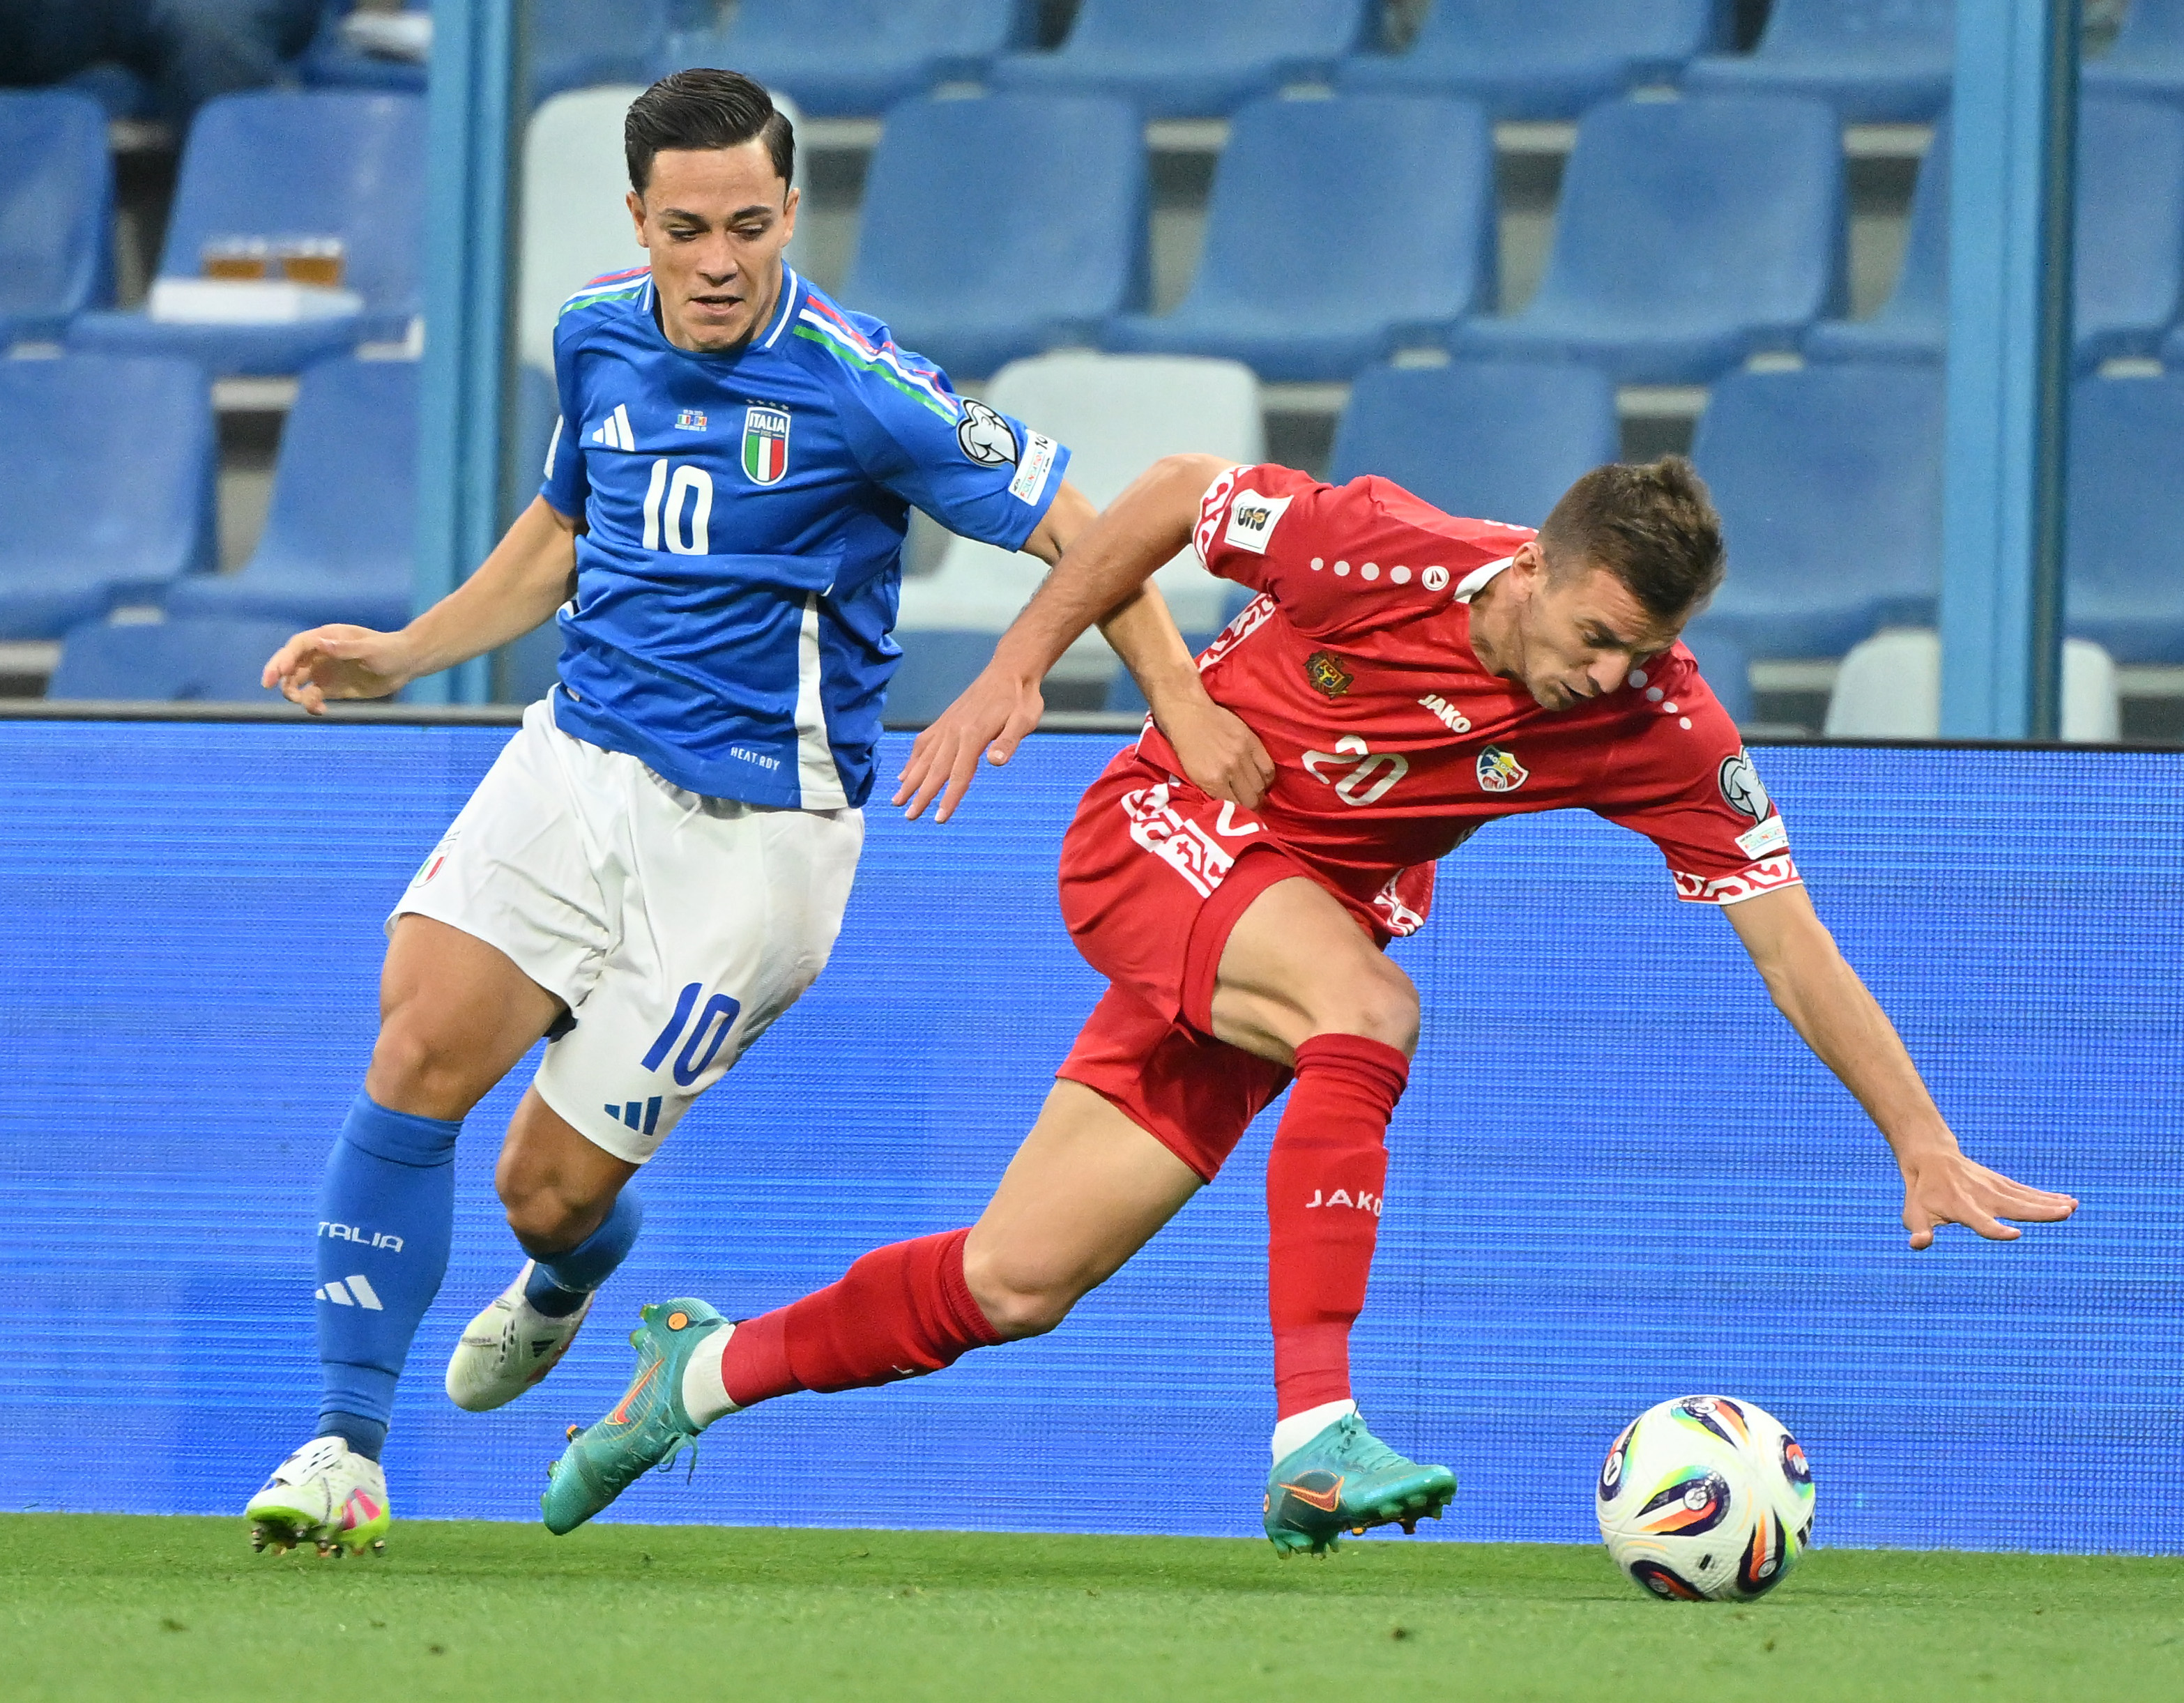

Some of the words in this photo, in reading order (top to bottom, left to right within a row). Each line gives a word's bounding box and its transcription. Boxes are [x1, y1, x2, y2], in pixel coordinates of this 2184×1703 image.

[749, 413, 785, 433] ITALIA
[1035, 436, 1048, 450] 10
[643, 459, 713, 555] 10
[1417, 694, 1472, 733] JAKO
[731, 747, 780, 771] HEAT.RDY
[1301, 735, 1408, 807] 20
[641, 982, 740, 1086] 10
[1306, 1189, 1383, 1217] JAKO
[317, 1221, 404, 1253] TALIA
